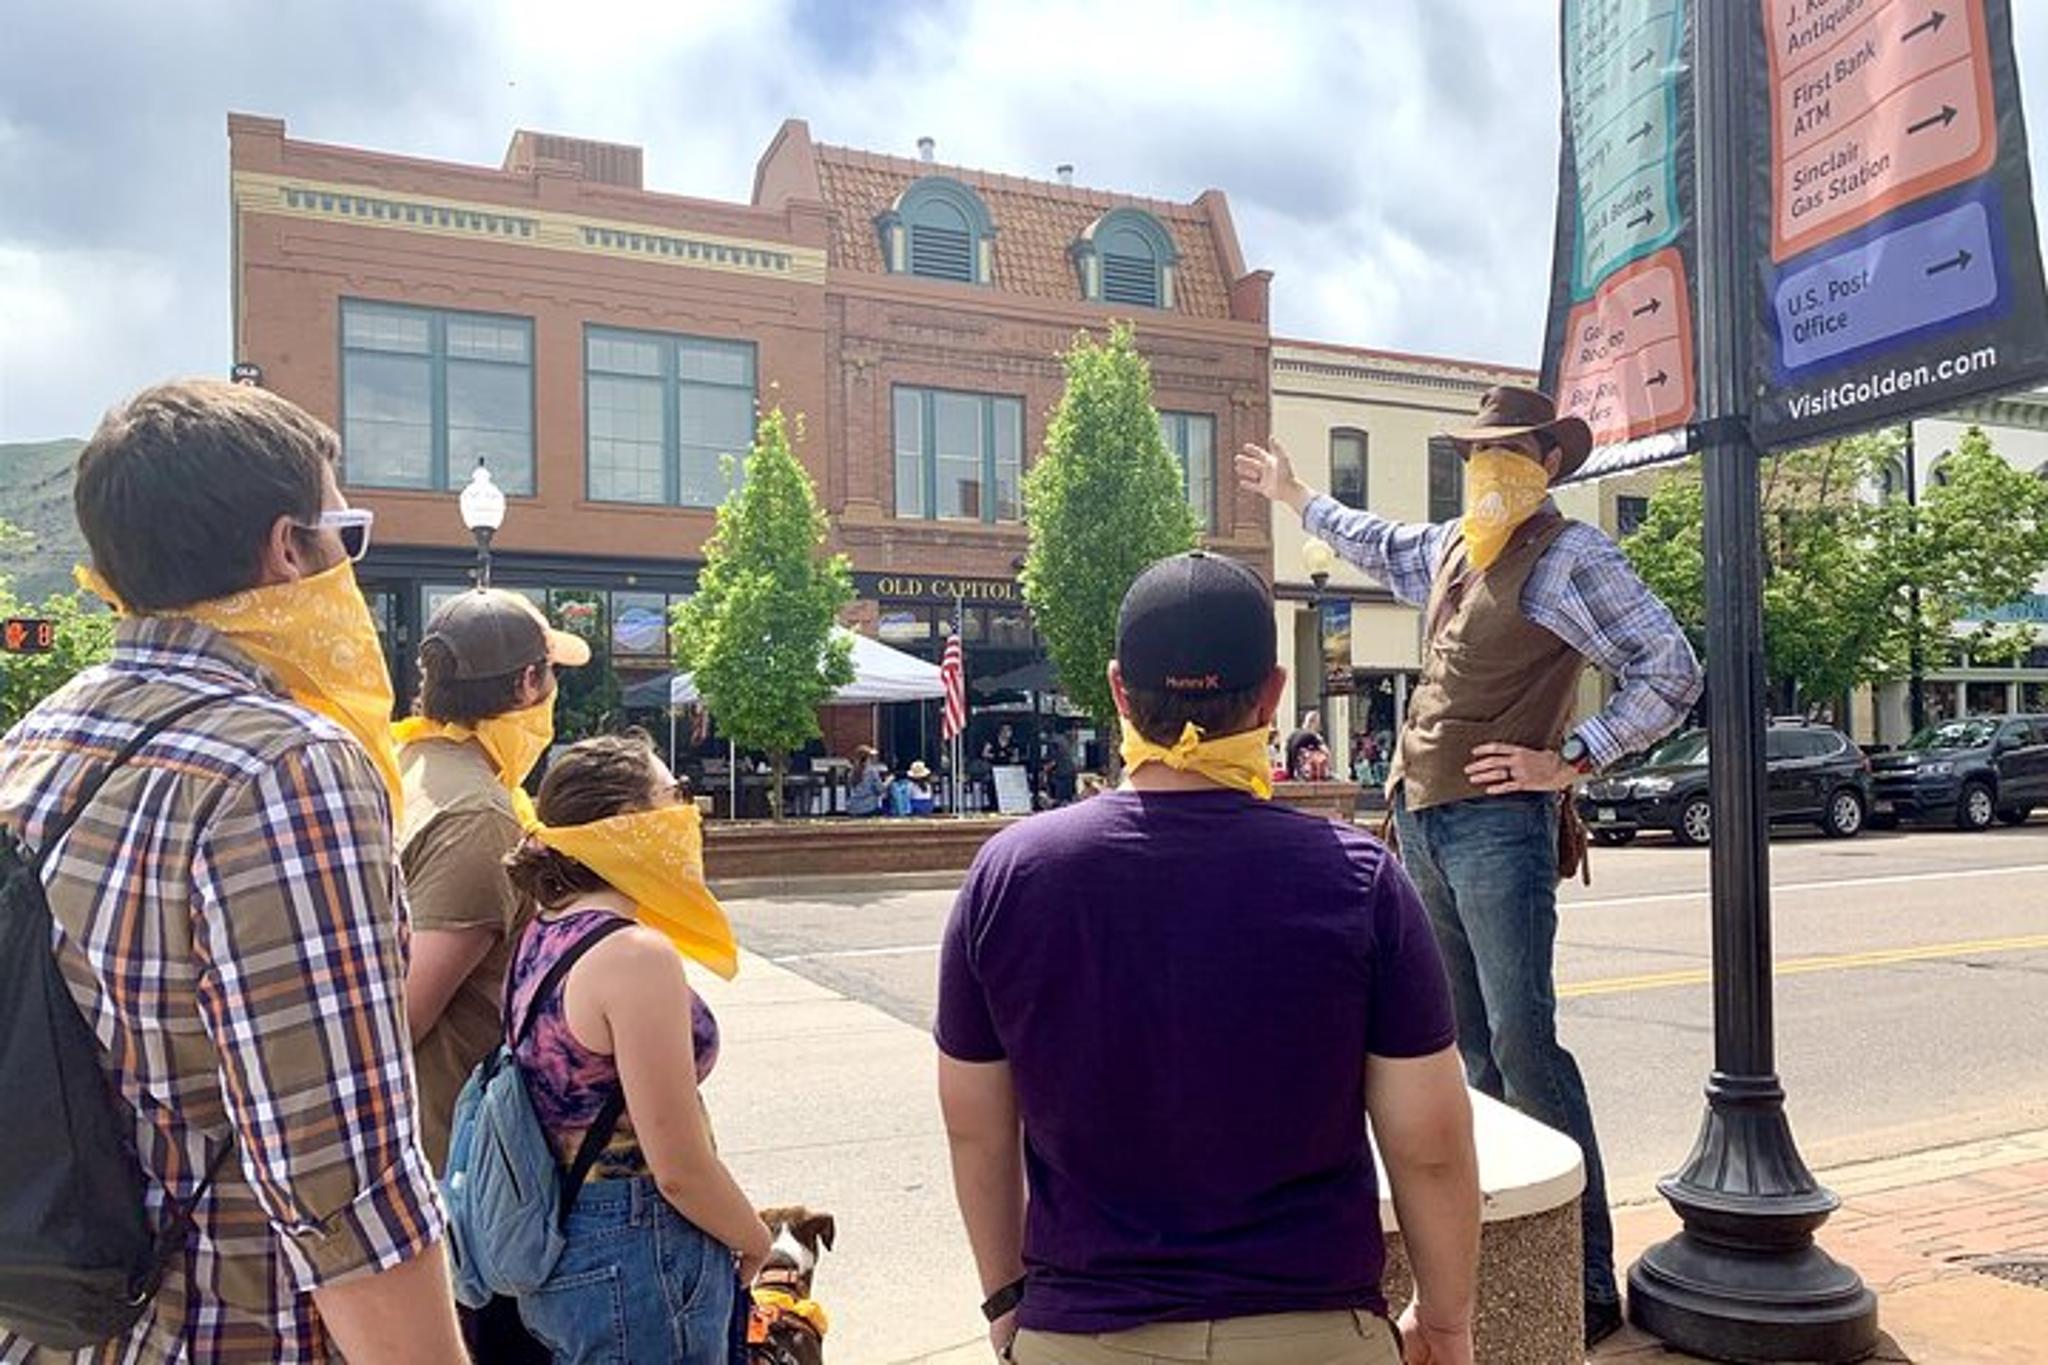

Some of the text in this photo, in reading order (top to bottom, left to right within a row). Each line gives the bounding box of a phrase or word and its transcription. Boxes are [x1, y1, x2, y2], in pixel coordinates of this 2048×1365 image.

[1793, 40, 1876, 109] First Bank
[1794, 99, 1830, 137] ATM
[1791, 153, 1890, 219] Gas Station
[1793, 141, 1859, 191] Sinclair
[1787, 270, 1868, 317] U.S. Post
[1792, 311, 1848, 344] Office
[1787, 345, 1997, 420] VisitGolden.com
[878, 577, 1016, 600] OLD CAPITOL
